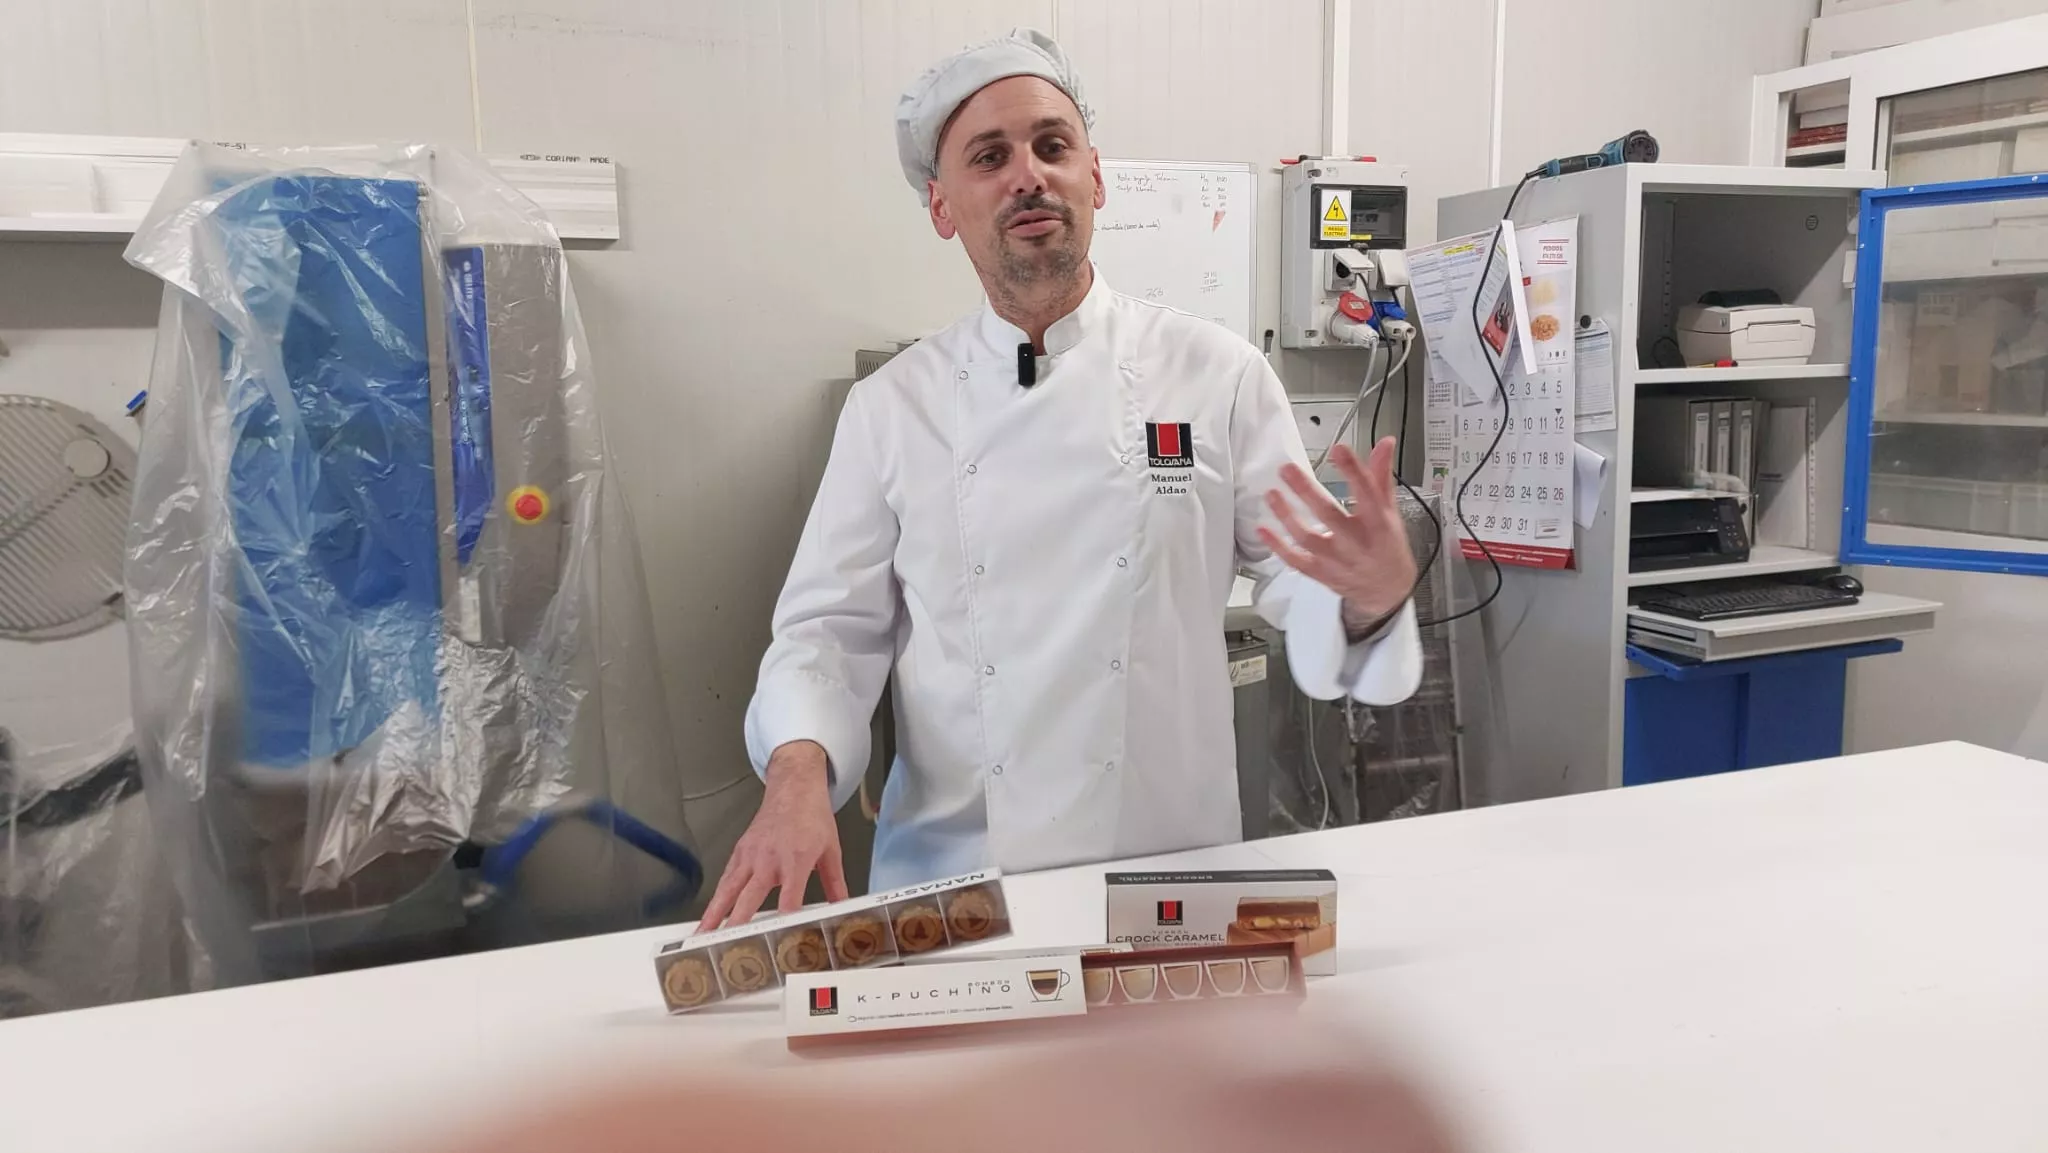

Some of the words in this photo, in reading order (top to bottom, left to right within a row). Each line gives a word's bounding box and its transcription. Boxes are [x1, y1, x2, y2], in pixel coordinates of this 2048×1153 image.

[1509, 383, 1515, 396] 2
[1525, 382, 1531, 396] 3
[1541, 381, 1546, 395] 4
[1556, 380, 1562, 394] 5
[1463, 419, 1469, 431] 6
[1477, 418, 1483, 430] 7
[1493, 418, 1499, 431] 8
[1508, 418, 1514, 430] 9
[1524, 417, 1533, 430] 10
[1540, 417, 1547, 430] 11
[1555, 416, 1564, 430] 12
[1462, 450, 1470, 463] 13
[1491, 452, 1500, 464] 15
[1506, 452, 1516, 464] 16
[1523, 452, 1532, 464] 17
[1539, 452, 1548, 464] 18
[1554, 452, 1564, 465] 19
[1151, 473, 1192, 482] Manuel
[1156, 486, 1187, 494] Aldao
[1474, 484, 1482, 496] 21
[1489, 485, 1499, 497] 22
[1505, 486, 1514, 498] 23
[1521, 486, 1532, 499] 24
[1537, 486, 1548, 500] 25
[1554, 487, 1564, 500] 26
[1468, 514, 1480, 527] 28
[1484, 516, 1496, 528] 29
[1501, 517, 1512, 530] 30
[1518, 518, 1528, 531] 31
[1115, 935, 1160, 943] CROCK
[1164, 934, 1225, 942] CARAMEL
